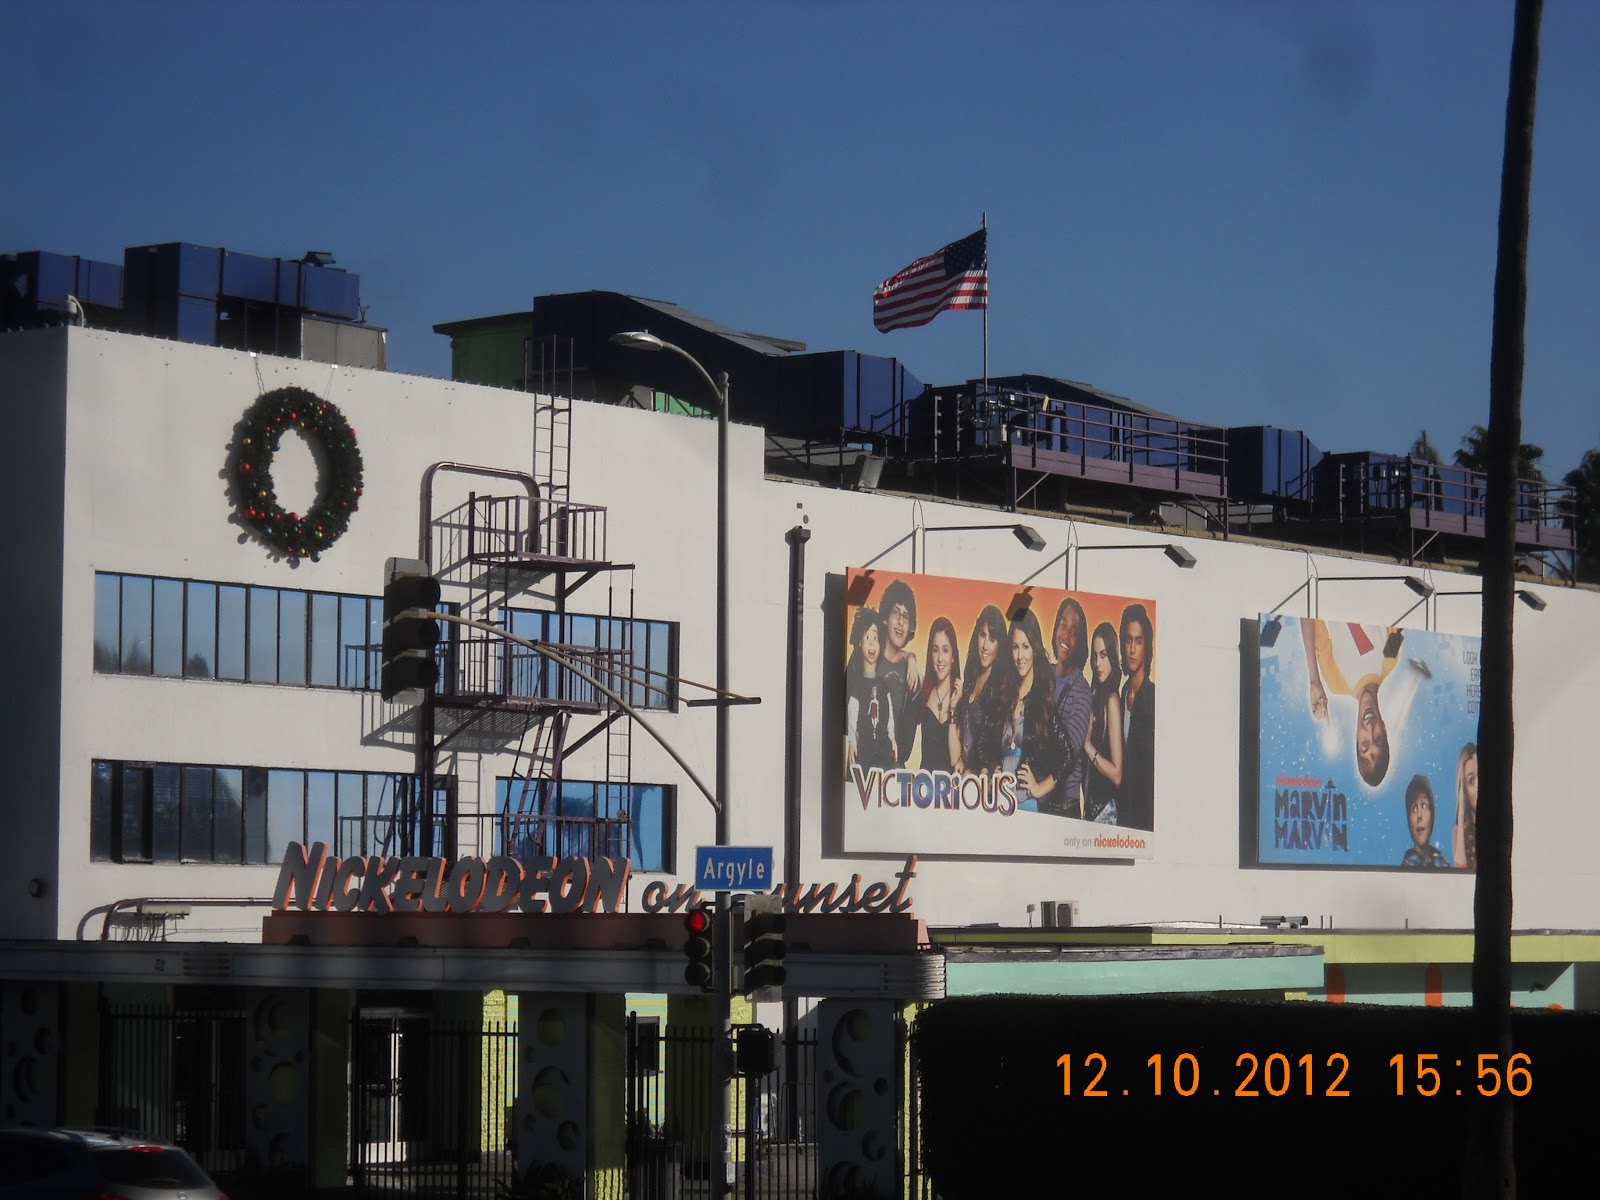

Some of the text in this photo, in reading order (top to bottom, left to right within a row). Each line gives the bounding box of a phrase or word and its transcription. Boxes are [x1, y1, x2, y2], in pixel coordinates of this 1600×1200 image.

[1063, 833, 1146, 849] only on nickelodeon
[642, 880, 707, 913] on
[760, 855, 918, 914] unset
[703, 857, 765, 888] Argyle
